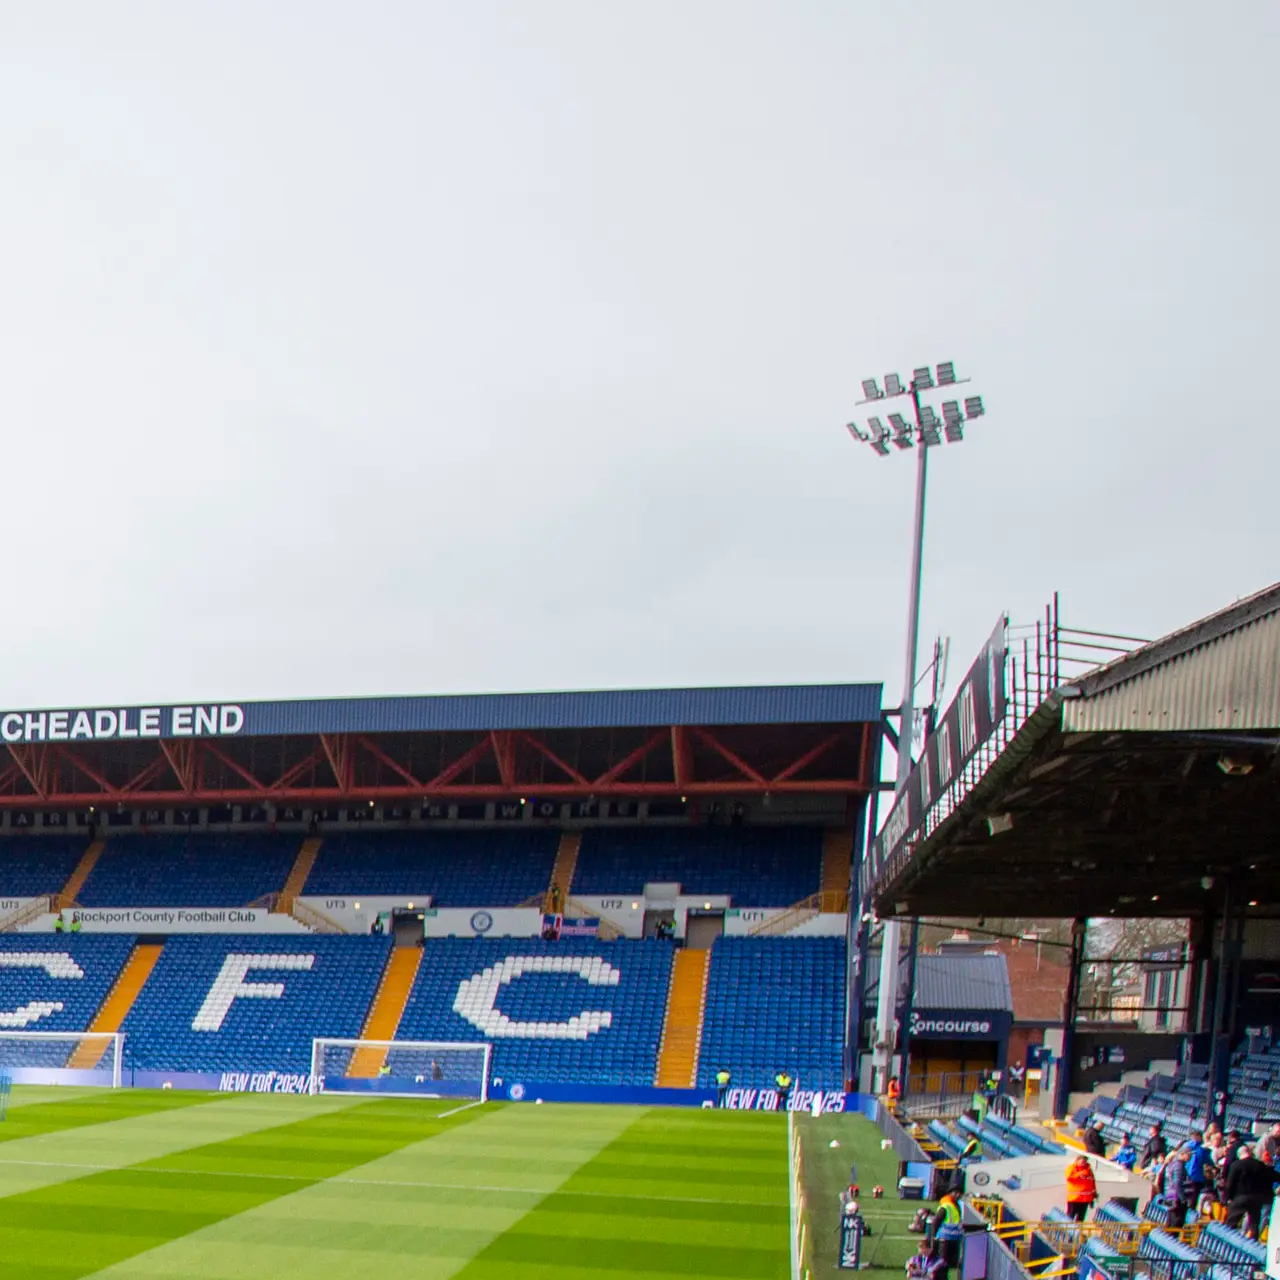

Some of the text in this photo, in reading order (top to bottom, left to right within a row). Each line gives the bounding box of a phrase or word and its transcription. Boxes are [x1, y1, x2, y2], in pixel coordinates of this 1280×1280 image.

[0, 708, 161, 741] CHEADLE
[171, 704, 244, 736] END
[601, 899, 623, 910] UT2
[73, 911, 256, 927] Stockport County Football Club
[191, 953, 316, 1032] F
[453, 956, 620, 1040] C
[219, 1072, 250, 1092] NEW
[249, 1072, 275, 1092] FOR
